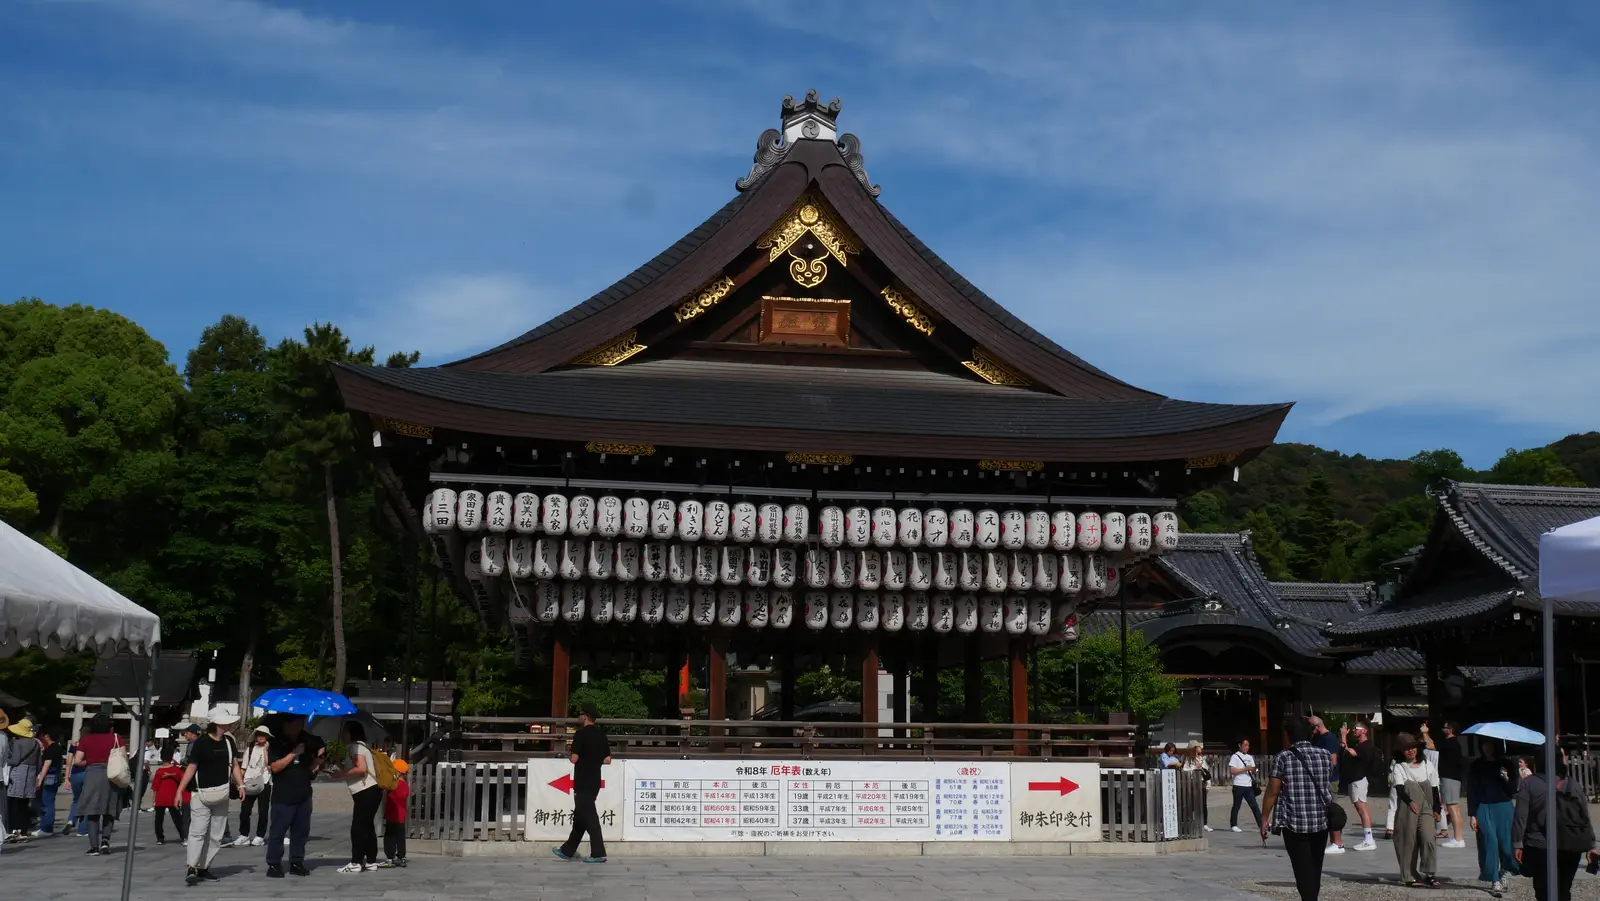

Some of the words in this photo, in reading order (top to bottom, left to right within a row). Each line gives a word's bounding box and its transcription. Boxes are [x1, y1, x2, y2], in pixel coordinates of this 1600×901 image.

[493, 494, 505, 526] 貴久政
[550, 497, 561, 530] 繁乃家
[577, 498, 589, 529] 富美代
[630, 500, 643, 533] いし初
[657, 501, 669, 533] 堀八重
[687, 504, 698, 535] 利きみ
[740, 505, 751, 538] ふく葉
[857, 508, 866, 542] まつもと
[985, 514, 996, 542] えん
[1010, 513, 1021, 545] 杉きみ
[1112, 516, 1122, 545] 叶家
[1137, 515, 1149, 546] 権兵衛
[1163, 513, 1176, 545] 権兵衛
[736, 767, 767, 776] 令和8年
[640, 792, 656, 800] 25歳
[793, 805, 809, 813] 33歳
[534, 809, 615, 827] 御祈付
[640, 817, 656, 825] 61歳
[1020, 811, 1092, 828] 御朱印受付
